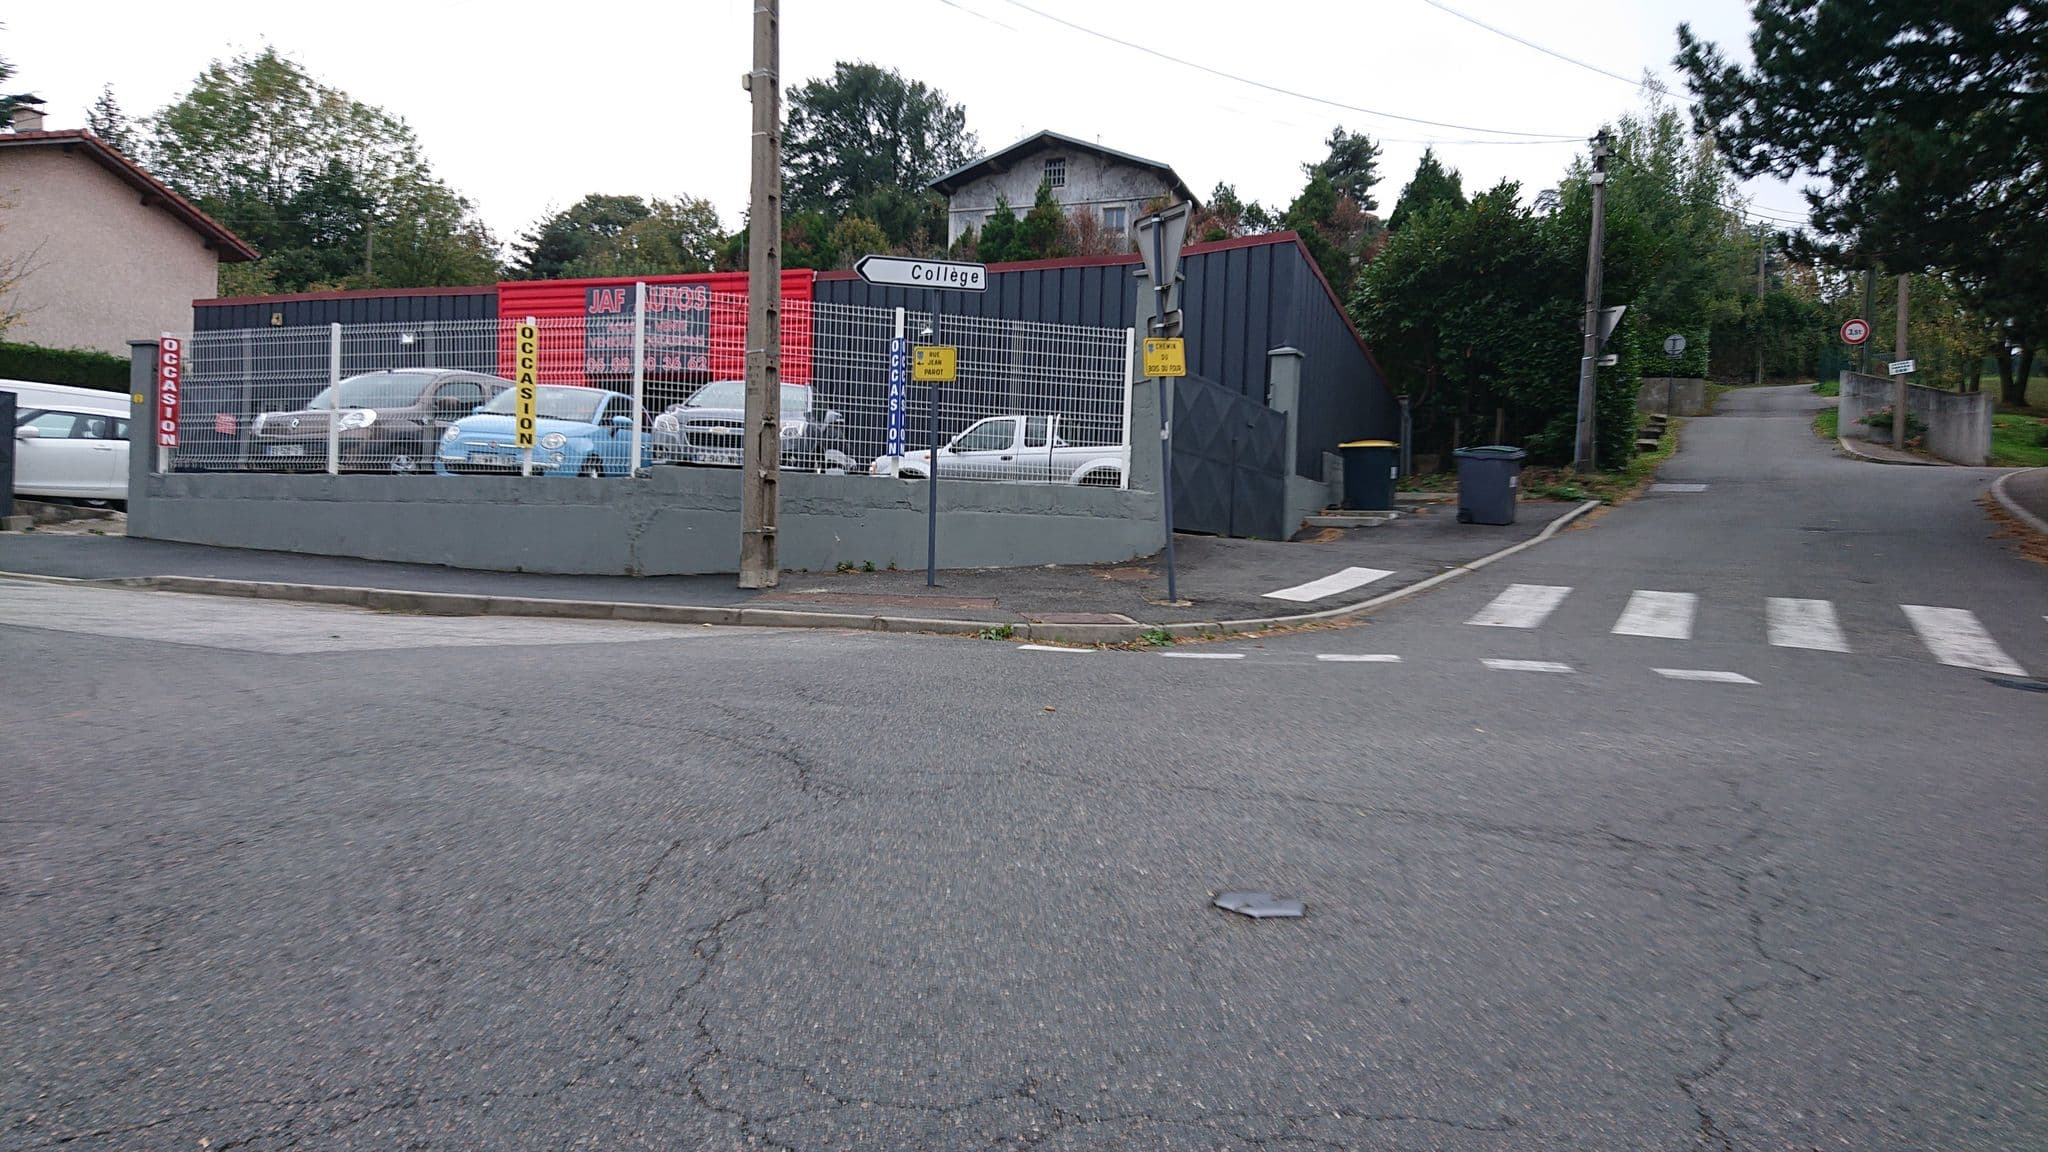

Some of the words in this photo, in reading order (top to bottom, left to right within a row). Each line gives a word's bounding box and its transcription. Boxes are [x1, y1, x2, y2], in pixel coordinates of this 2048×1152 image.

[911, 264, 979, 287] Collège
[588, 288, 626, 314] JAF
[633, 286, 707, 313] AUTOS
[586, 357, 606, 372] 06
[662, 356, 681, 371] 36
[687, 355, 707, 371] 62
[924, 368, 944, 376] PAROT
[161, 339, 178, 446] OCCASION
[519, 326, 534, 445] OCCASION
[888, 339, 899, 455] OCCASION
